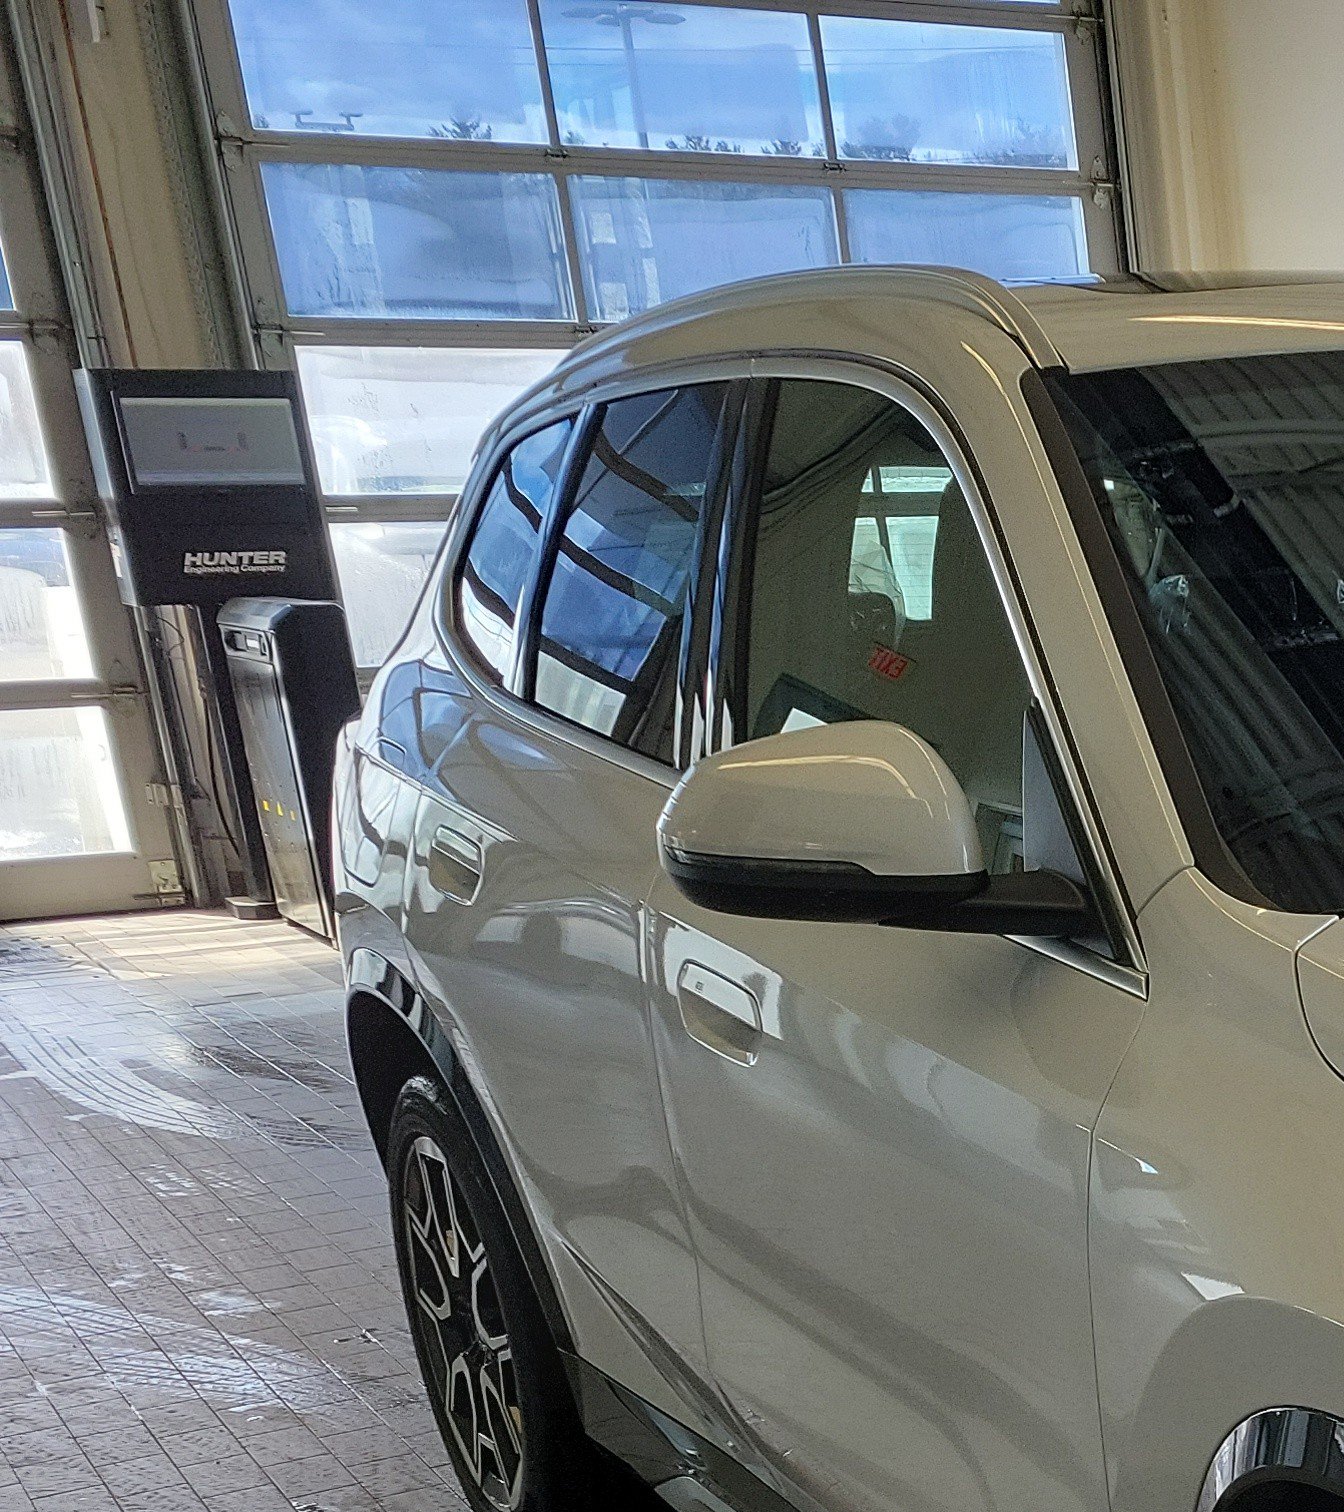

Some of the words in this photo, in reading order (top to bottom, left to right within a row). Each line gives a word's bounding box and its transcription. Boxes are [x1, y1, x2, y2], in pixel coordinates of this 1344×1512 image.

[184, 550, 286, 566] HUNTER
[183, 564, 241, 574] Engineering
[240, 564, 286, 573] Company
